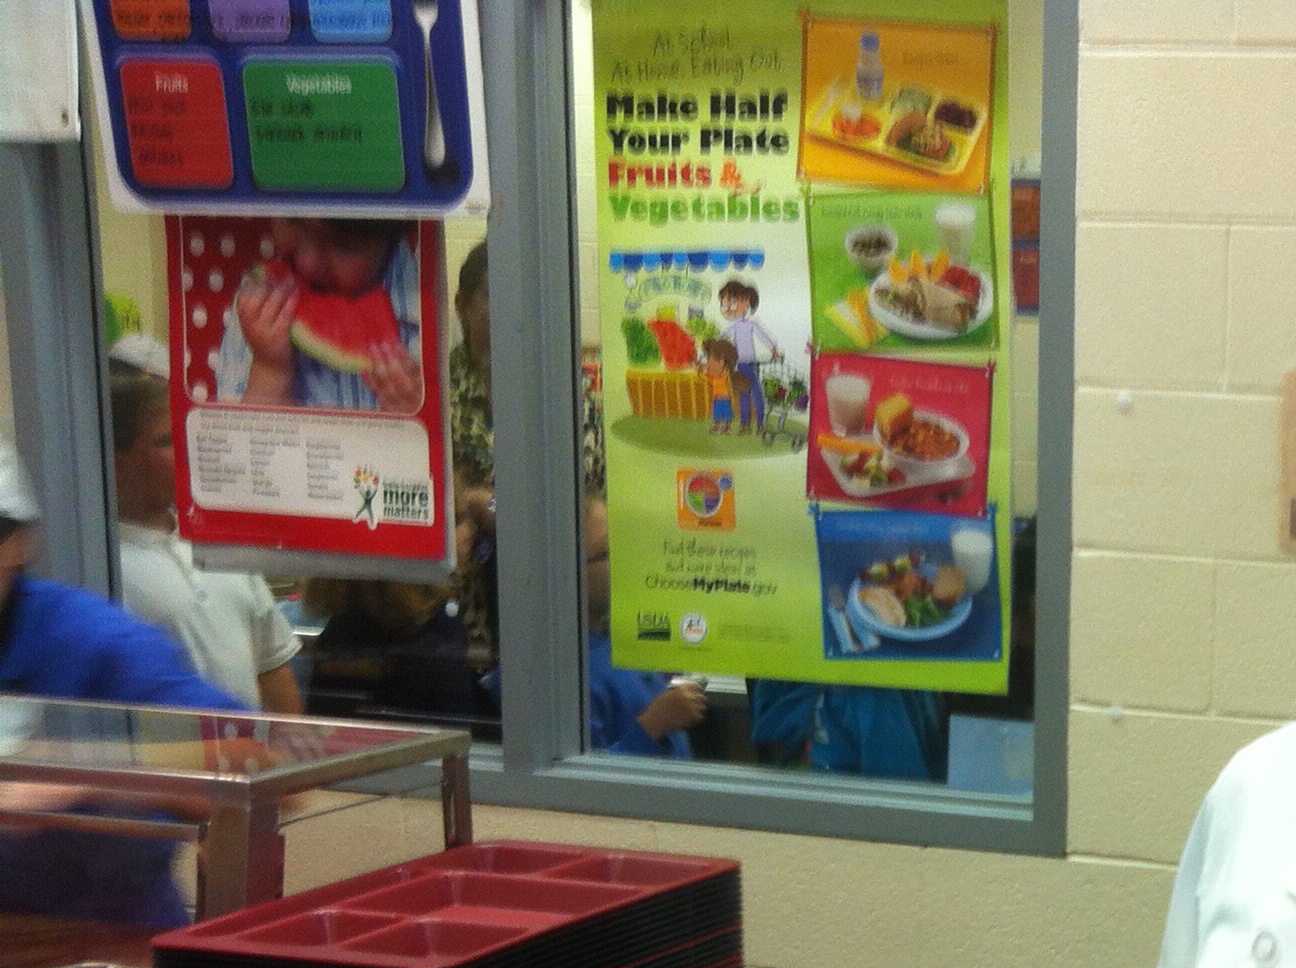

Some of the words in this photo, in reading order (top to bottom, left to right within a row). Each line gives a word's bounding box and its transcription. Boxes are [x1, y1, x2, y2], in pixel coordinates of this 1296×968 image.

[154, 71, 189, 94] Fruits
[285, 73, 353, 95] Vegetables
[605, 88, 699, 123] Make
[709, 88, 789, 123] Half
[607, 126, 691, 156] Your
[700, 126, 791, 156] Plate
[607, 158, 712, 189] Fruits
[607, 193, 801, 228] Vegetables
[382, 488, 429, 506] more
[382, 505, 430, 519] matters
[636, 610, 671, 628] USDA
